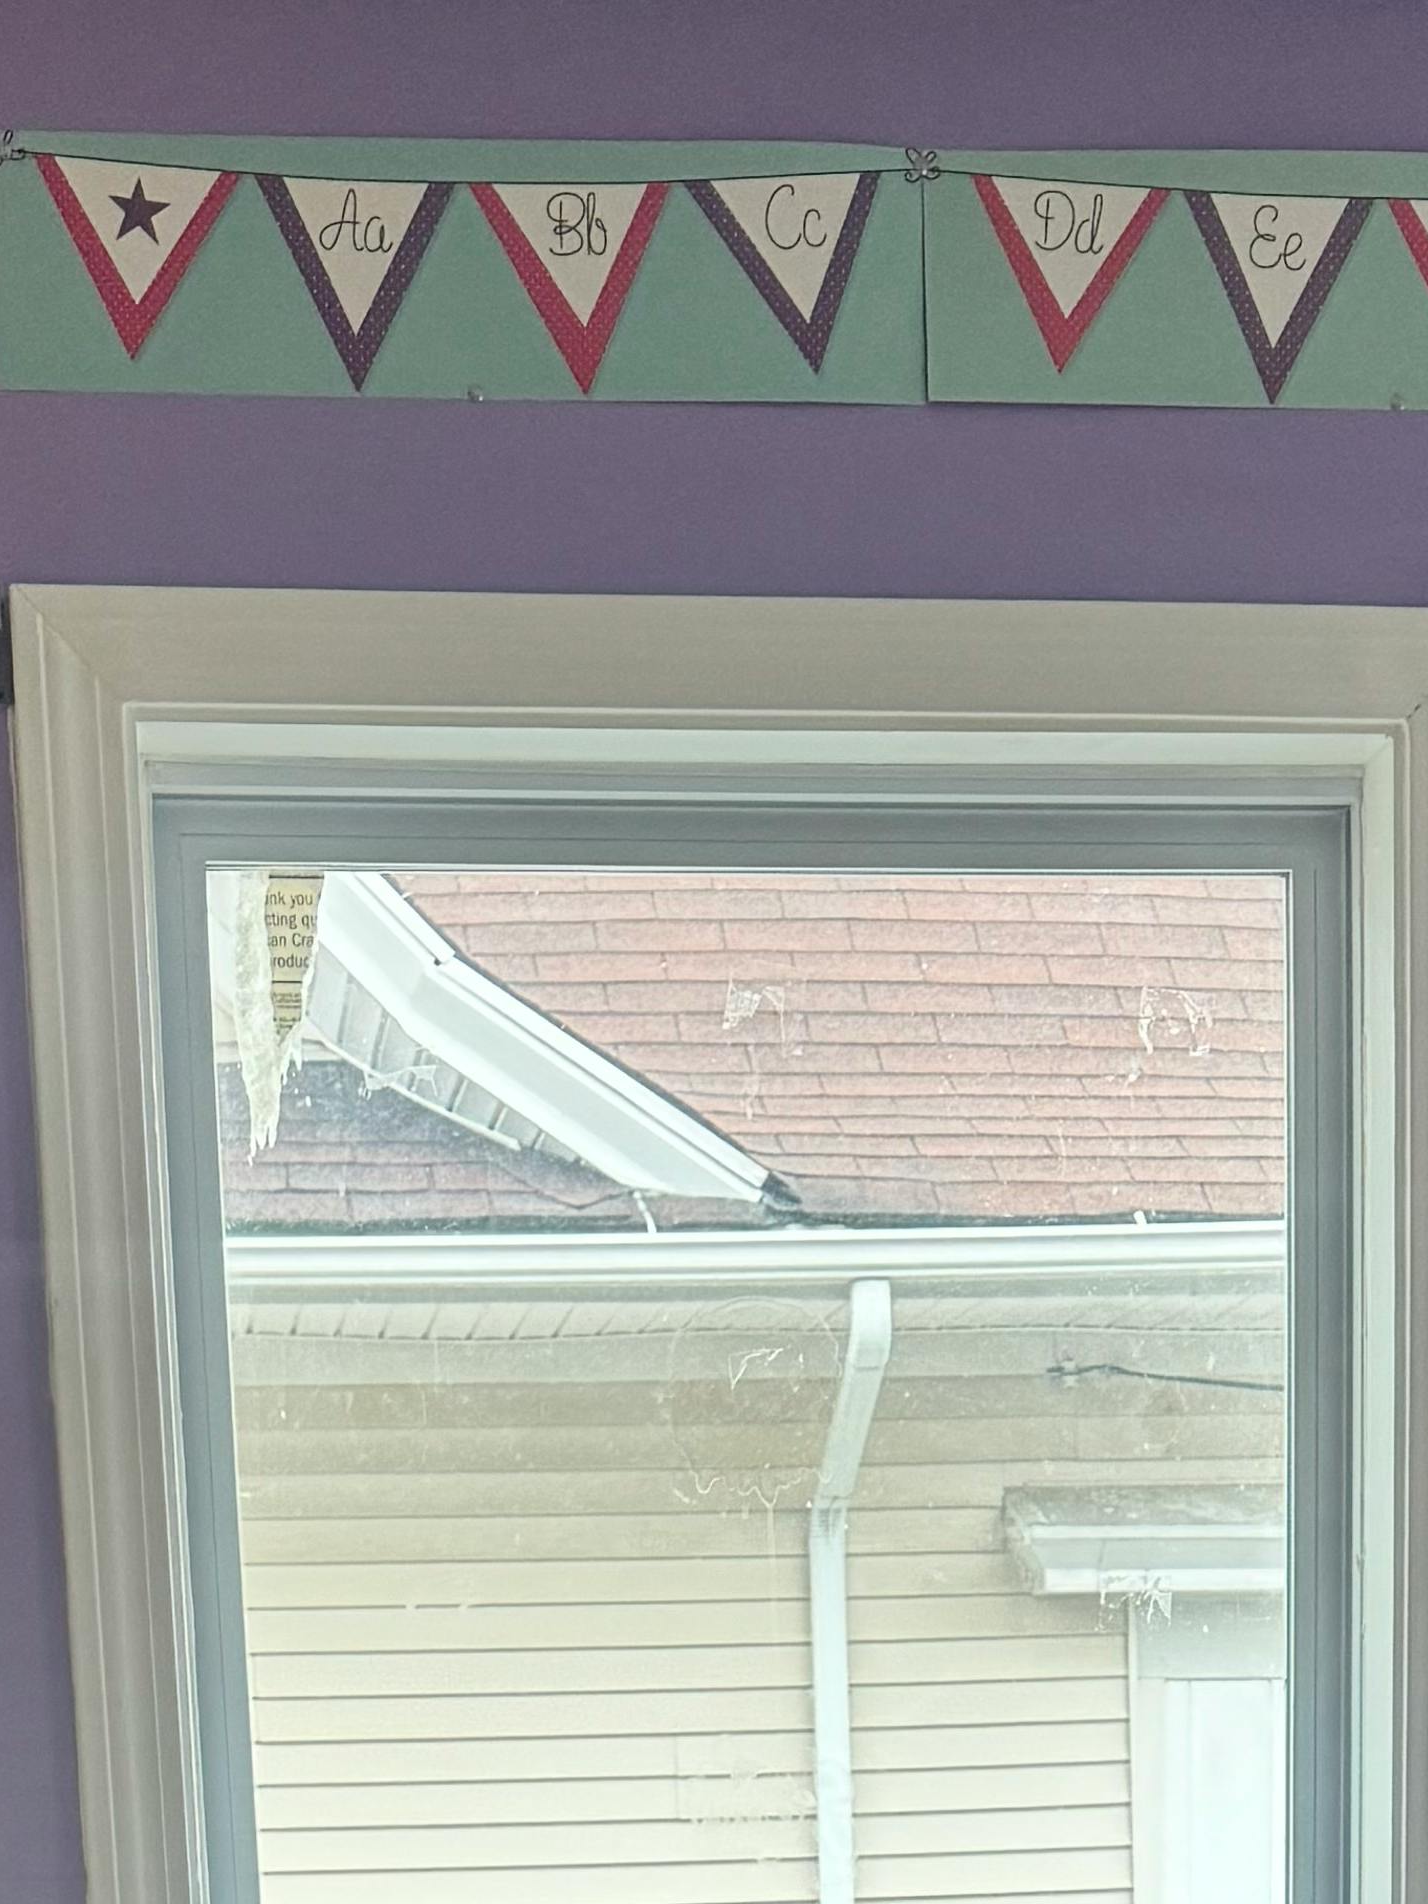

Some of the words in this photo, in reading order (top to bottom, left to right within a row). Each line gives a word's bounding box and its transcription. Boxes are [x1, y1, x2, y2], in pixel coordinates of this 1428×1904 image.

[318, 209, 395, 256] Aa
[546, 191, 608, 257] Bb
[764, 184, 828, 251] Cc
[1033, 190, 1105, 257] Dd
[1248, 204, 1307, 272] Ee
[290, 893, 313, 909] you
